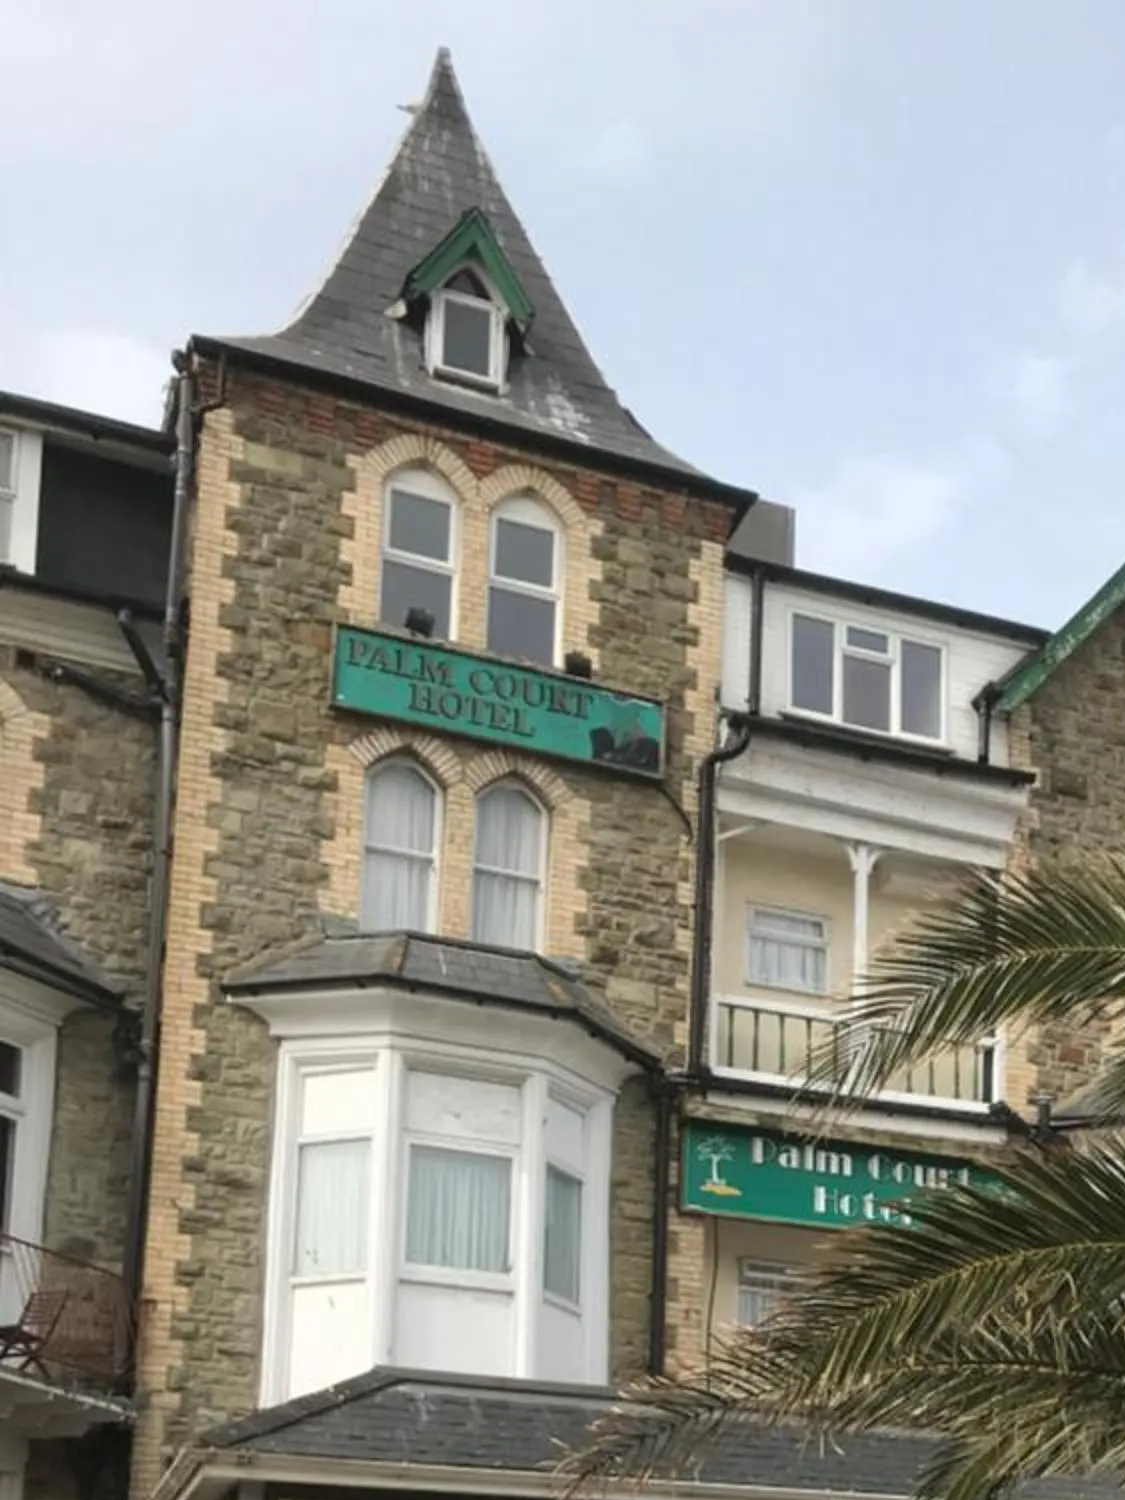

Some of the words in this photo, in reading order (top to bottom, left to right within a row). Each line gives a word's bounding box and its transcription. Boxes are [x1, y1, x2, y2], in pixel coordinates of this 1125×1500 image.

[346, 638, 456, 688] PALM
[469, 669, 594, 719] COURT
[408, 683, 536, 737] HOTEL
[751, 1136, 853, 1177] Palm
